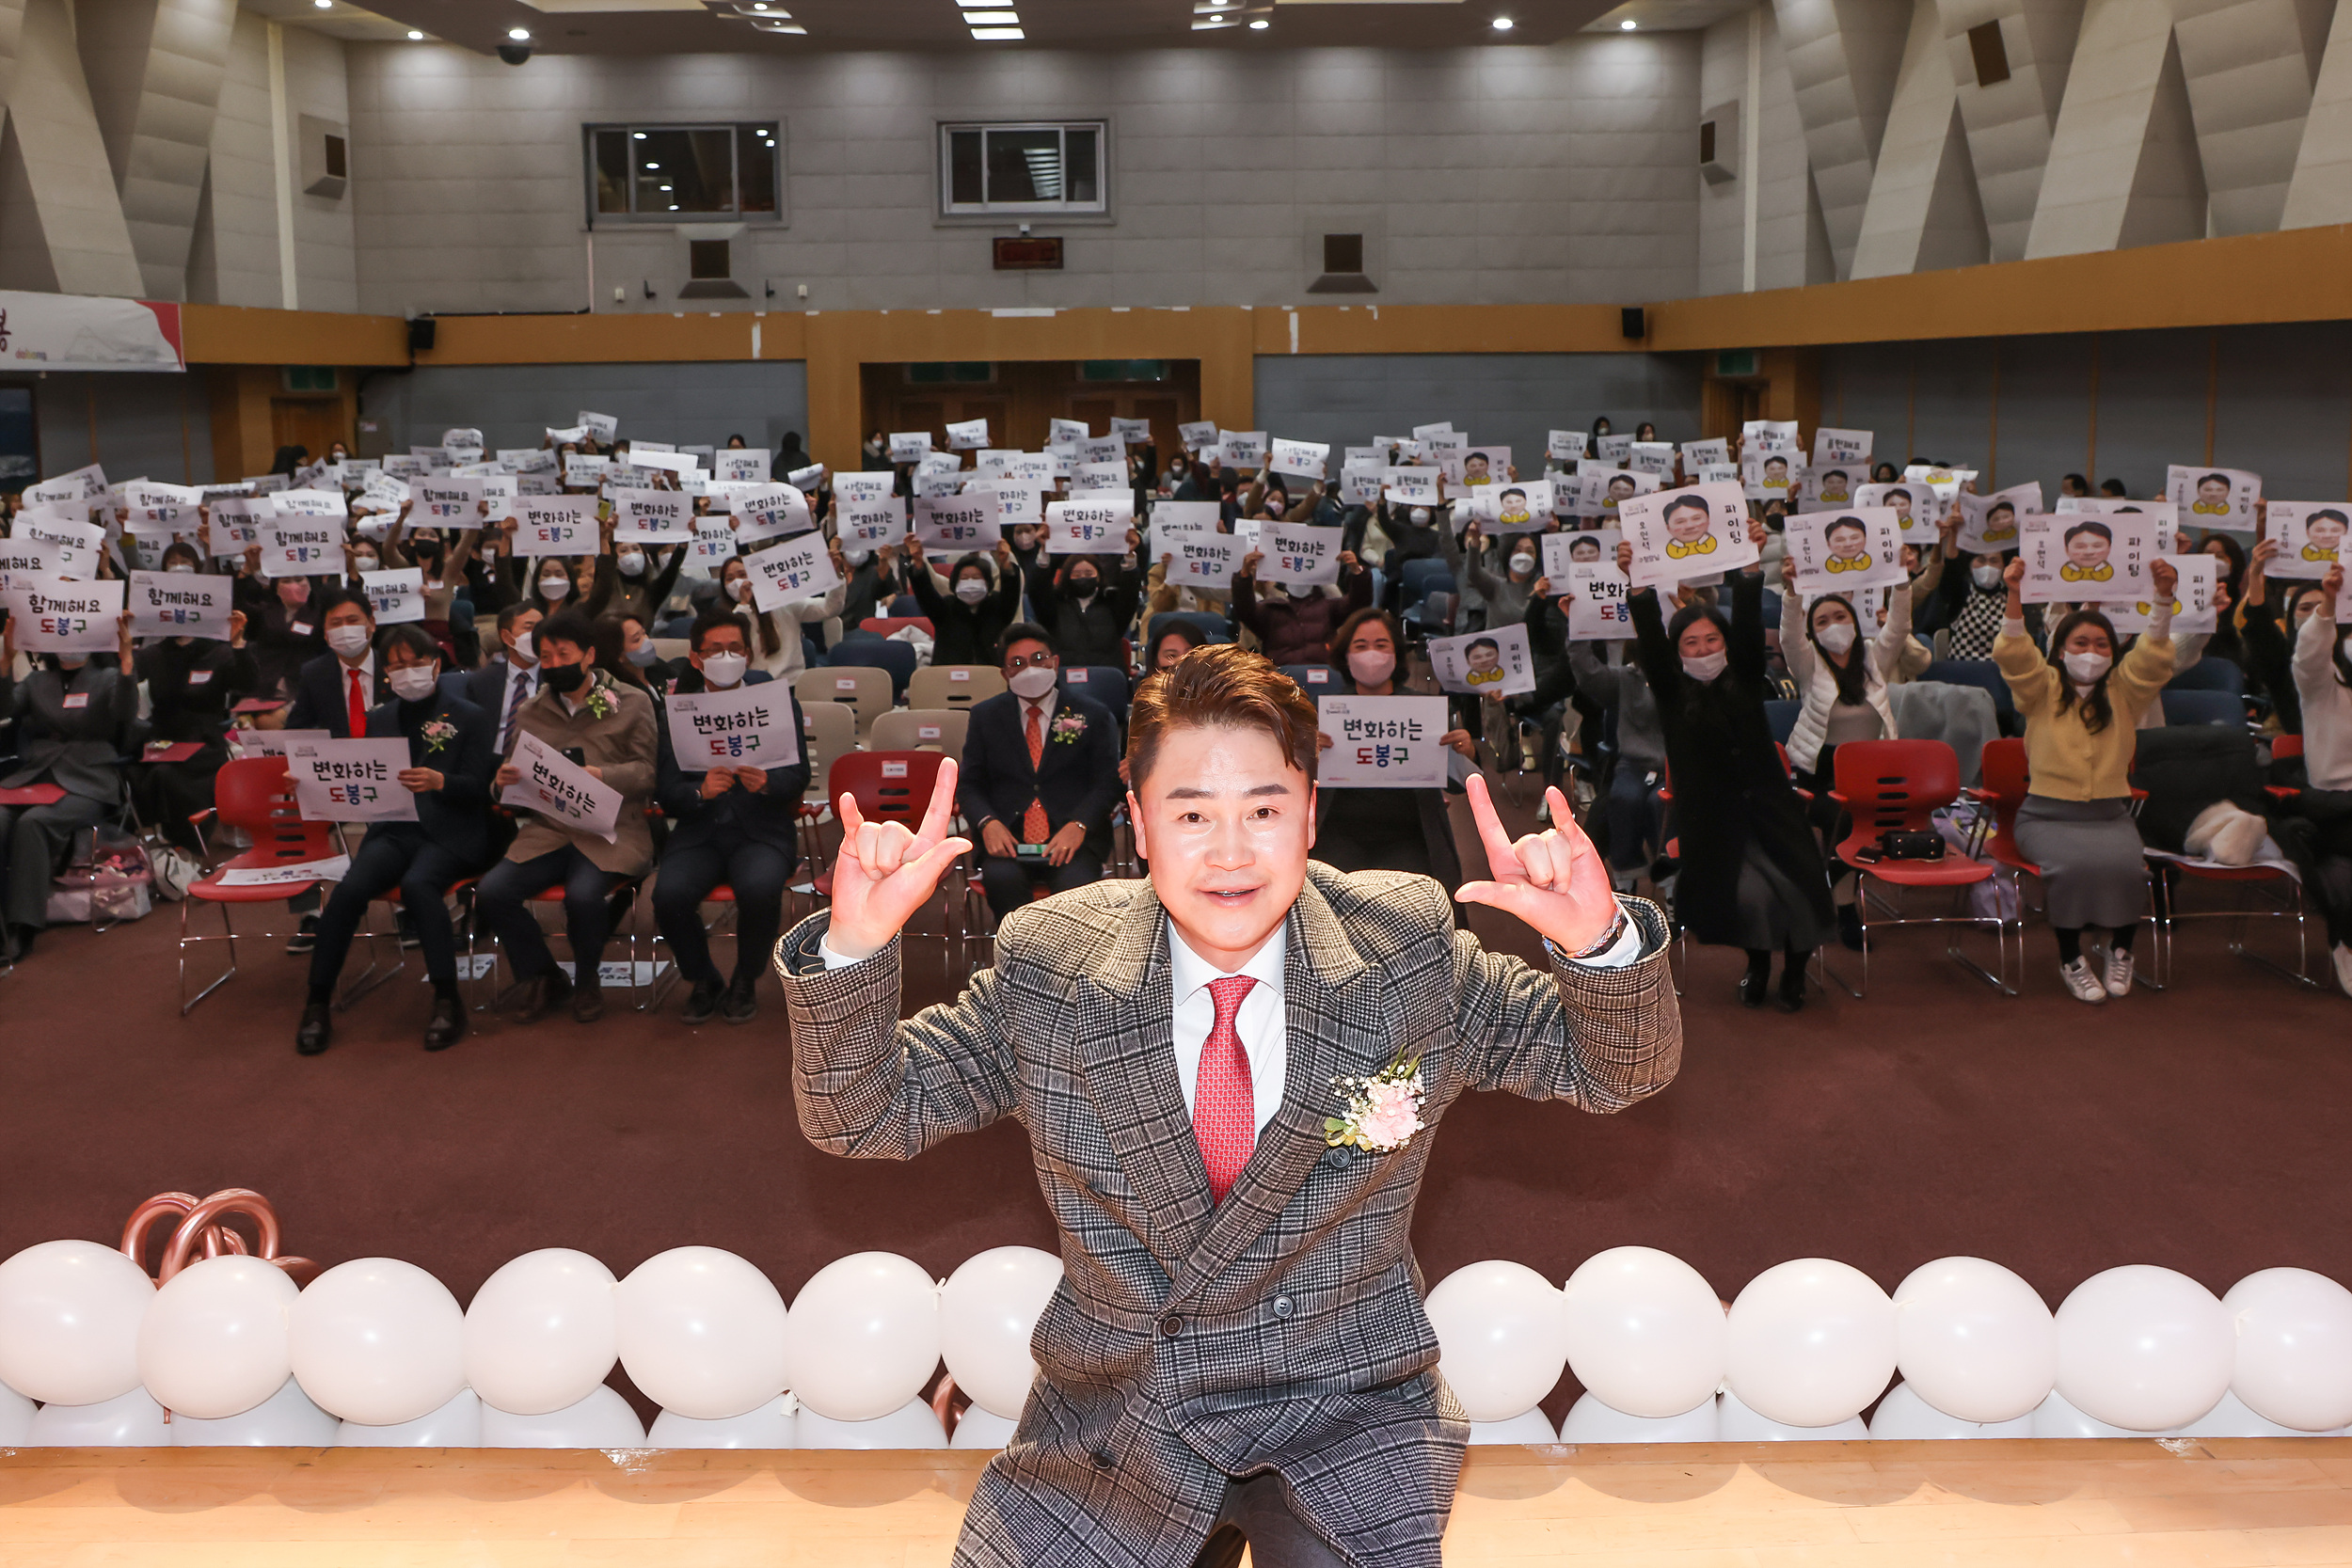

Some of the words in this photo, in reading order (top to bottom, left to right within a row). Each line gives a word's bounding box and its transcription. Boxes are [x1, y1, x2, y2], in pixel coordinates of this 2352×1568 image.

[422, 488, 469, 502] 함께해요
[845, 482, 882, 492] 사랑해요
[745, 493, 790, 514] 변화하는
[850, 493, 876, 501] 도봉구
[147, 508, 179, 521] 도봉구
[432, 504, 462, 516] 도봉구
[631, 501, 679, 517] 변화하는
[930, 508, 983, 525] 변화하는
[1063, 509, 1114, 523] 변화하는
[528, 510, 581, 525] 변화하는
[638, 518, 670, 531] 도봉구
[756, 510, 787, 526] 도봉구
[850, 512, 893, 527] 변화하는
[1724, 504, 1741, 544] 파이팅
[230, 528, 256, 542] 도봉구
[276, 531, 329, 546] 함께해요
[538, 527, 573, 543] 도봉구
[858, 527, 887, 539] 도봉구
[941, 526, 977, 540] 도봉구
[1071, 525, 1104, 541] 도봉구
[698, 543, 726, 556] 도봉구
[1183, 544, 1232, 562] 변화하는
[1275, 537, 1325, 557] 변화하는
[1880, 528, 1894, 563] 파이팅
[286, 547, 321, 562] 도봉구
[2128, 537, 2140, 578] 파이팅
[763, 552, 814, 578] 변화하는
[1190, 562, 1221, 576] 도봉구
[1281, 557, 1315, 572] 도봉구
[777, 570, 811, 592] 도봉구
[28, 594, 101, 613] 함께해요
[149, 588, 214, 607] 함께해요
[159, 609, 201, 625] 도봉구
[1601, 602, 1629, 623] 도봉
[40, 617, 87, 636] 도봉구
[693, 705, 770, 735] 변화하는
[1343, 719, 1422, 741] 변화하는
[709, 735, 761, 757] 도봉구
[1357, 745, 1408, 768] 도봉구
[313, 760, 388, 782] 변화하는
[329, 784, 378, 805] 도봉구
[532, 761, 596, 814] 변화하는
[538, 788, 581, 820] 도봉구
